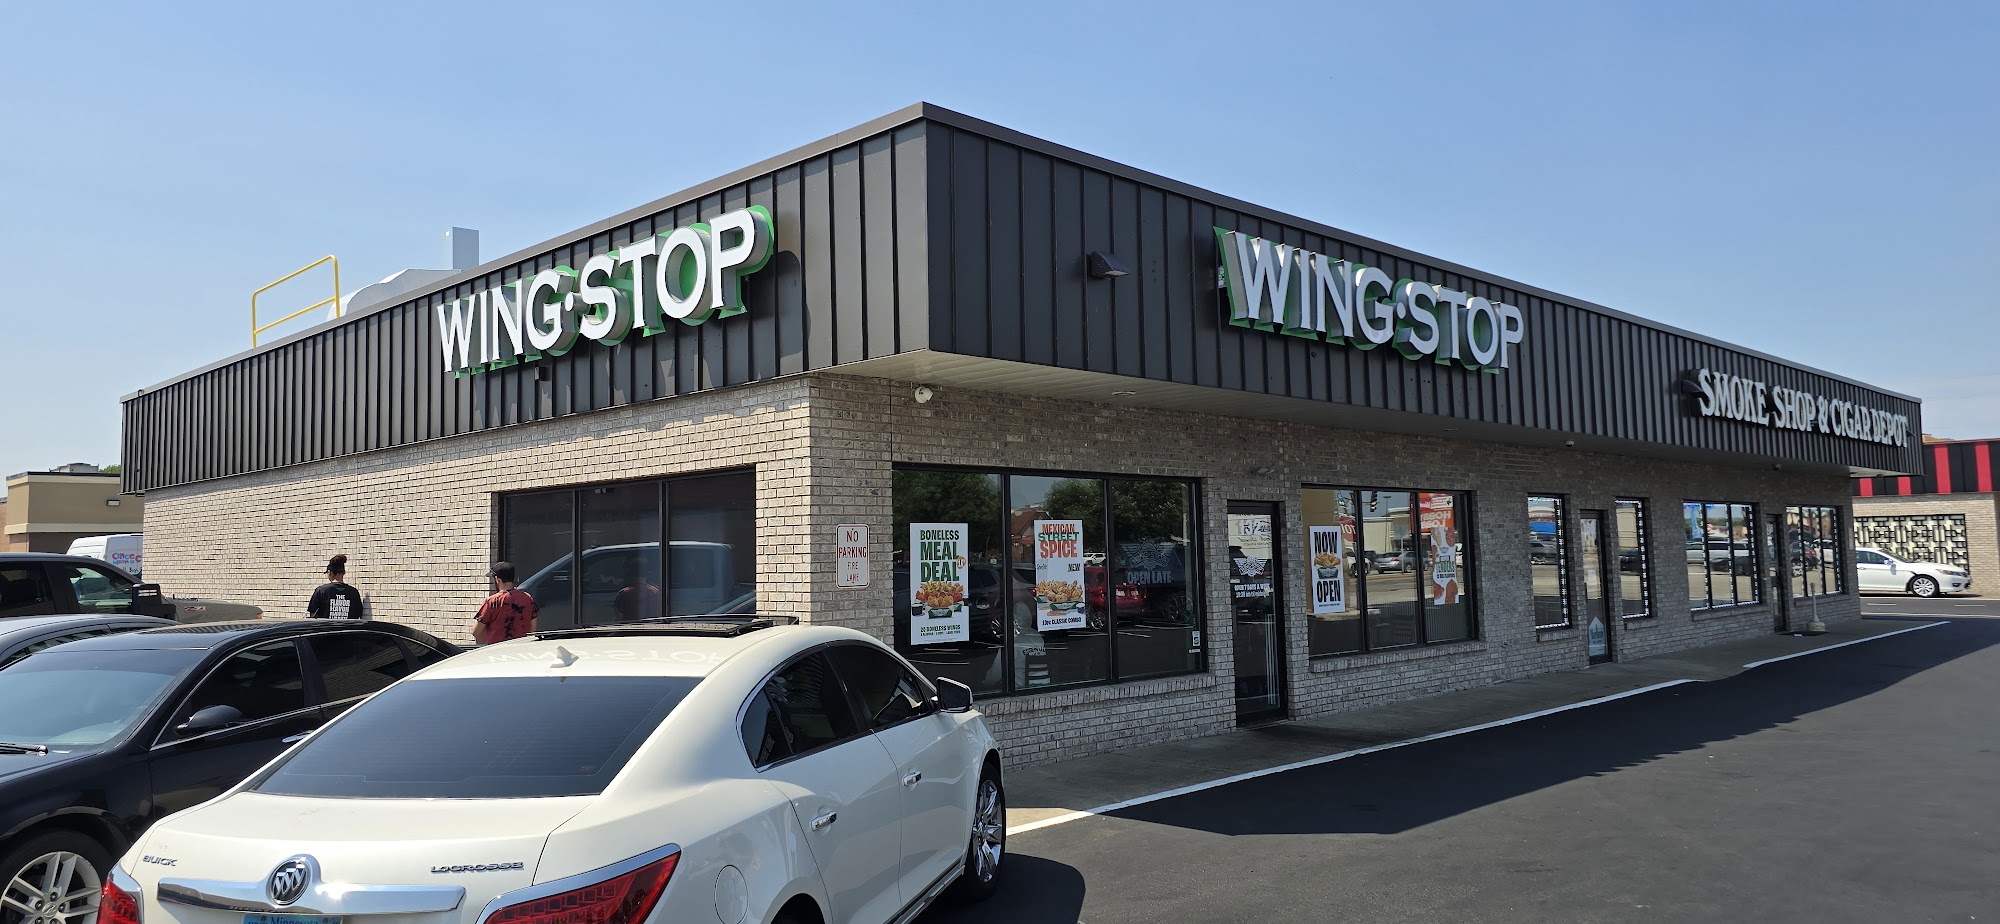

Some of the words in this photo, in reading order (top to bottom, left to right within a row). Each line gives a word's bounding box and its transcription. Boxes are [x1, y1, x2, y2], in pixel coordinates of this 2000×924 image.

[1698, 367, 1770, 427] SMOKE
[1772, 384, 1817, 432] SHOP
[1817, 394, 1830, 434] &
[1830, 398, 1873, 442] CIGAR
[1870, 407, 1909, 448] DEPOT
[920, 529, 960, 541] BONELESS
[1041, 523, 1075, 535] MEXICAN
[846, 530, 859, 542] NO
[1037, 531, 1080, 542] STREET
[1313, 531, 1338, 553] NOW
[838, 546, 867, 559] PARKING
[920, 541, 960, 561] MEAL
[1040, 540, 1078, 559] SPICE
[847, 561, 859, 570] FIRE
[1068, 563, 1081, 572] NEW
[846, 573, 860, 582] LANE
[920, 561, 960, 583] DEAL
[1127, 570, 1151, 585] OPEN
[1151, 570, 1172, 584] LATE
[1316, 579, 1342, 603] OPEN
[1051, 617, 1068, 625] CLASSIC
[1067, 616, 1082, 624] COMBO
[142, 855, 179, 867] BUICK
